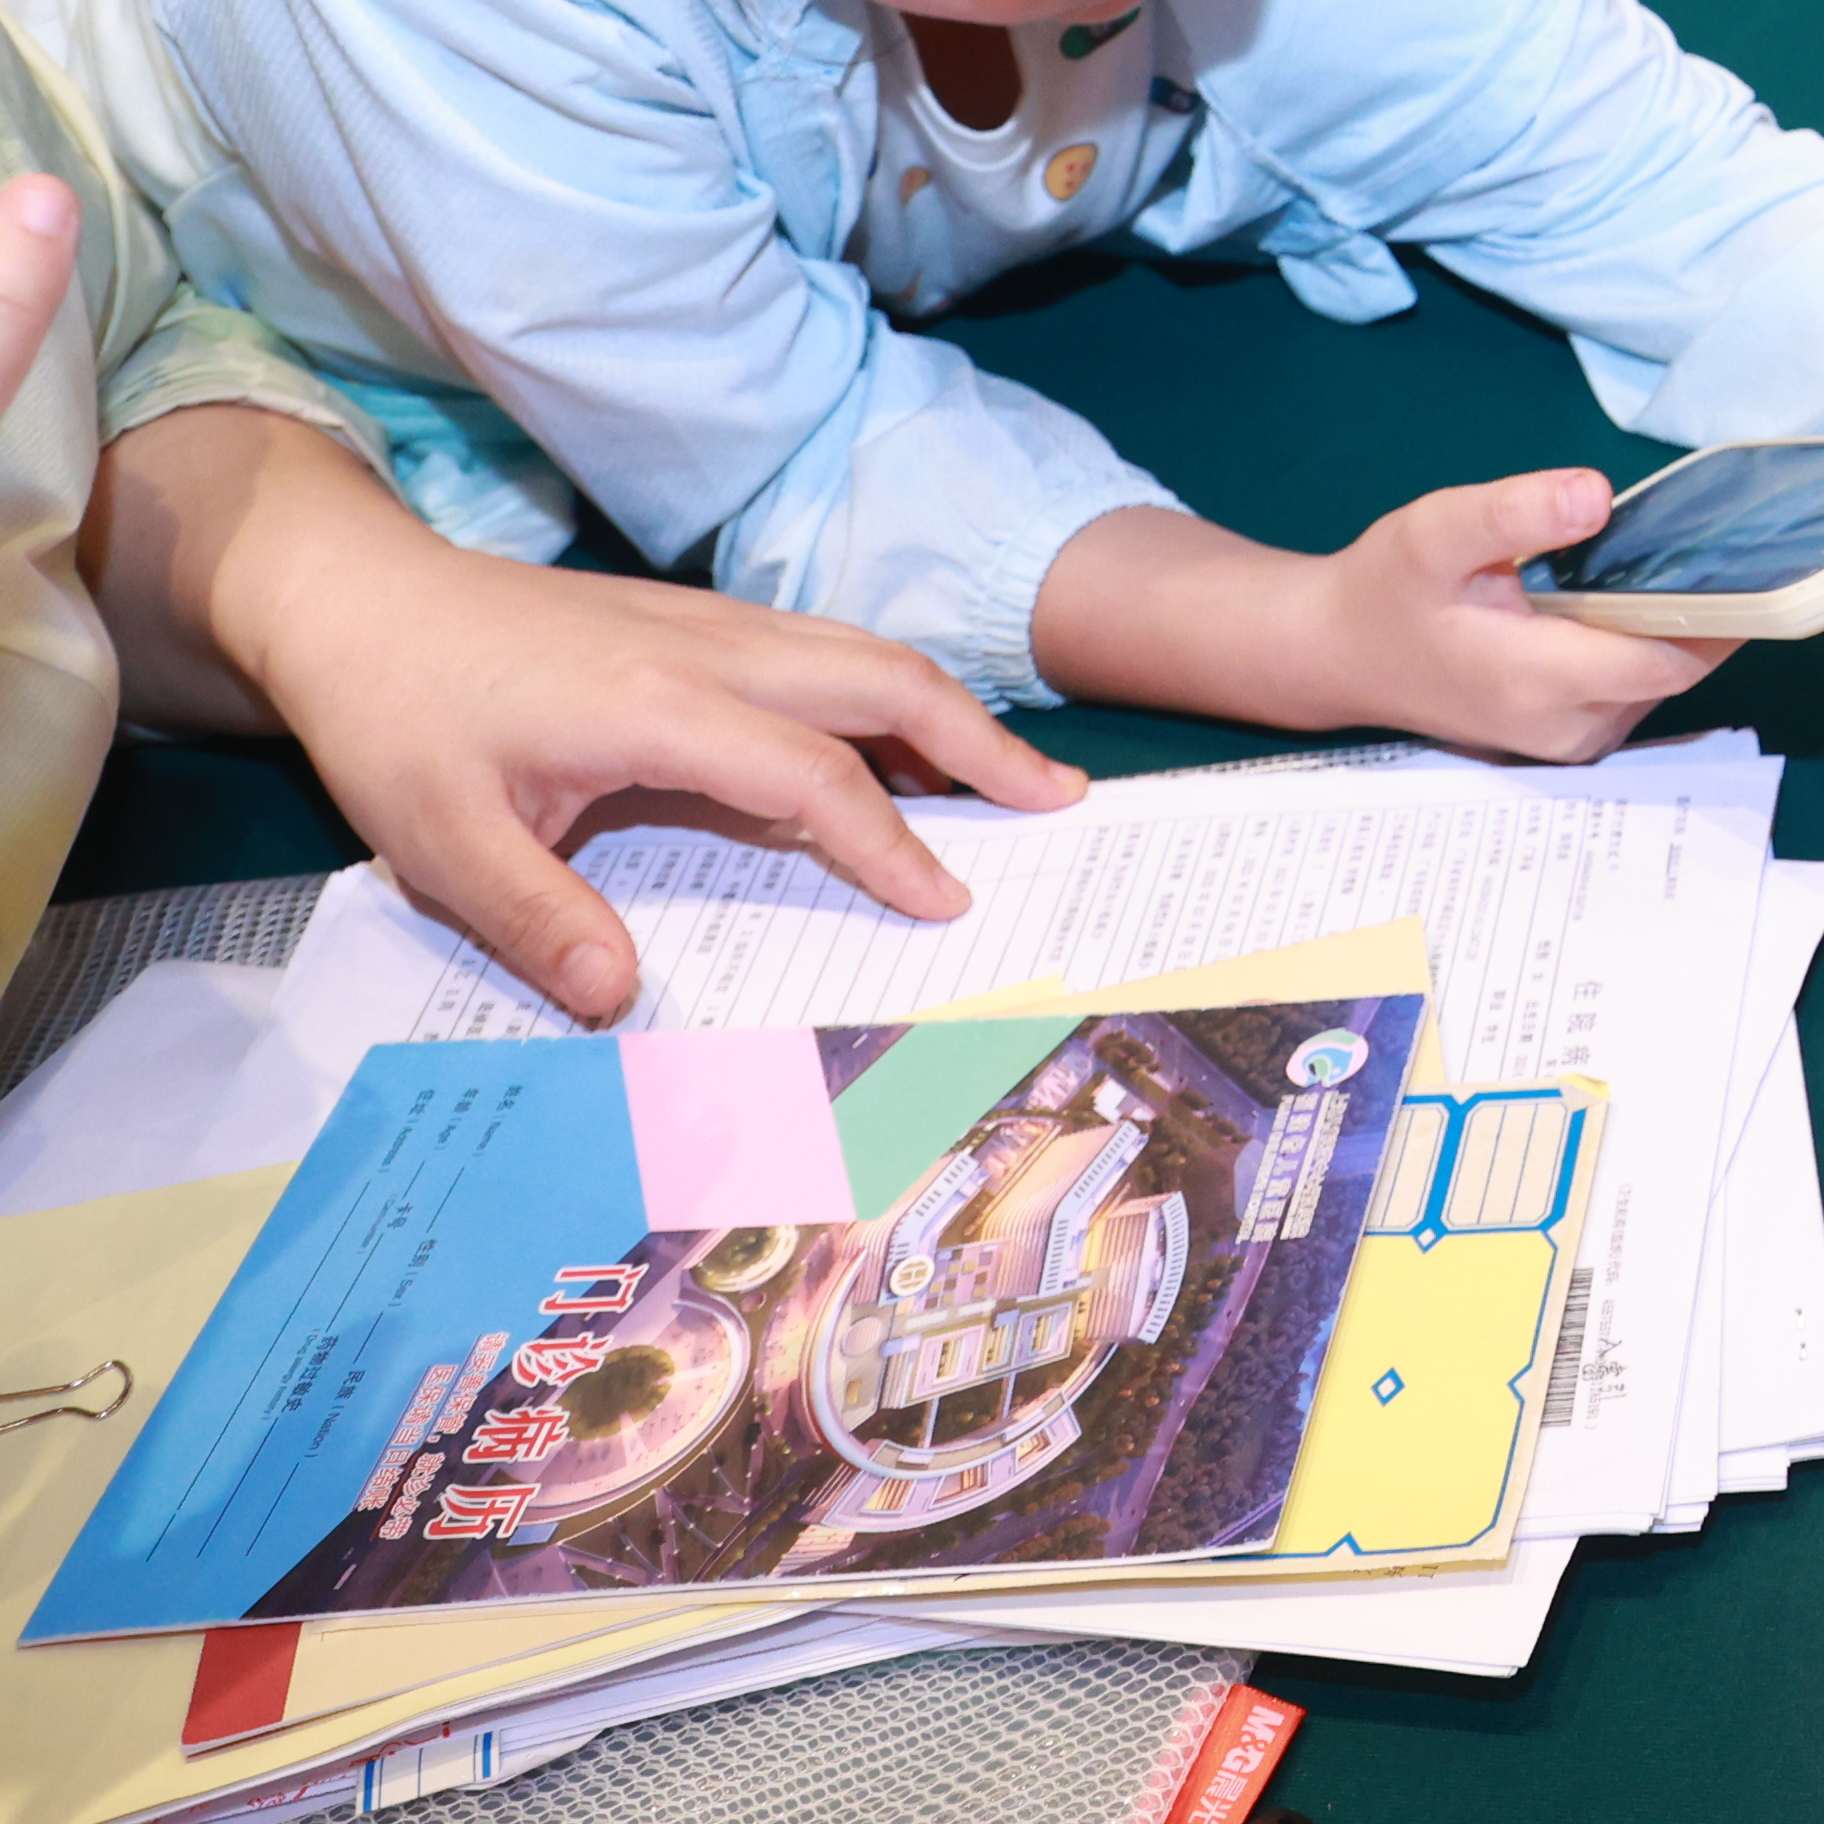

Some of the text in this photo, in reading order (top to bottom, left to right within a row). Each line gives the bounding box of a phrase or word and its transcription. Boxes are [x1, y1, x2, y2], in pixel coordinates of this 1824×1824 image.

[357, 1363, 458, 1513] 医保请当日结账
[379, 1331, 511, 1540] 请妥善保管，就诊必带
[423, 1262, 650, 1540] 门诊病历
